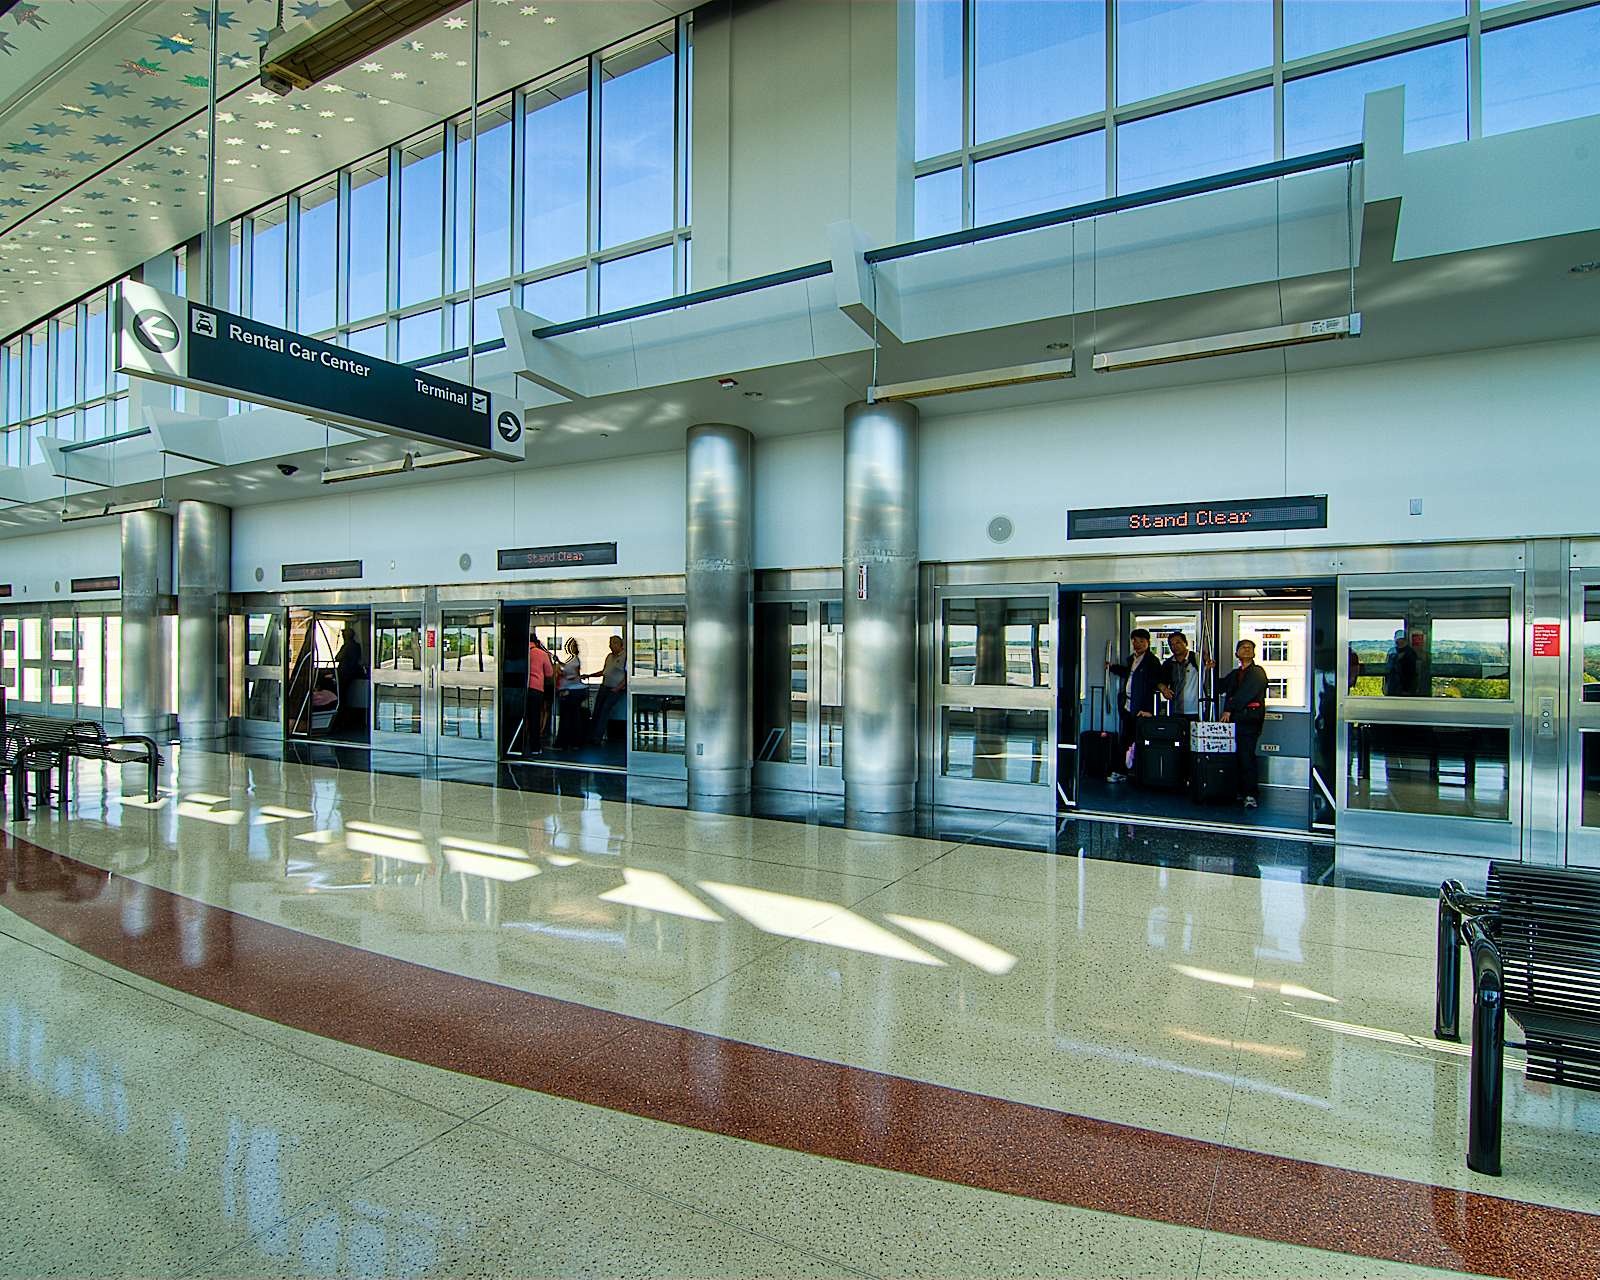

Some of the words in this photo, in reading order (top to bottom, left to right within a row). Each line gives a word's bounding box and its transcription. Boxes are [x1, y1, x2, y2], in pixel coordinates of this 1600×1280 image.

[229, 323, 284, 353] Rental
[289, 342, 318, 362] Car
[320, 351, 371, 377] Center
[414, 378, 468, 406] Terminal
[1129, 512, 1188, 529] Stand
[1196, 509, 1252, 526] Clear
[527, 552, 555, 564] Stand
[558, 552, 584, 562] Clear
